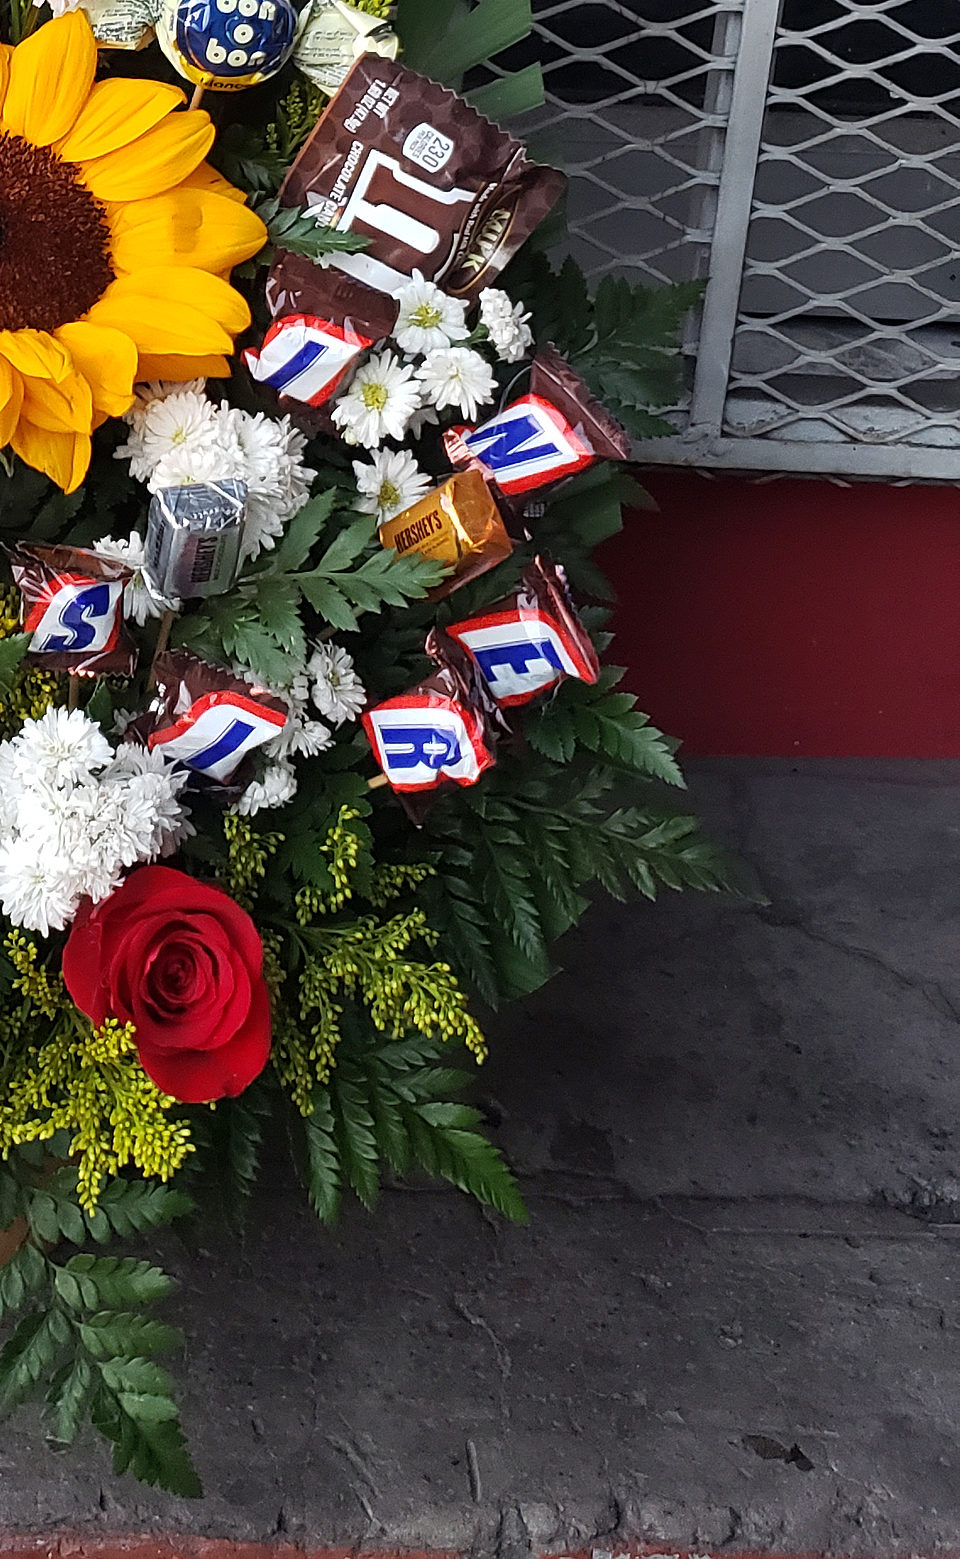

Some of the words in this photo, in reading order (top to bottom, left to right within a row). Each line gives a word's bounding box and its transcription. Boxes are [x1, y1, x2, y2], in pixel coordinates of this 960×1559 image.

[204, 38, 266, 68] bon
[422, 136, 450, 168] 230
[329, 140, 364, 203] CHOCOLATE
